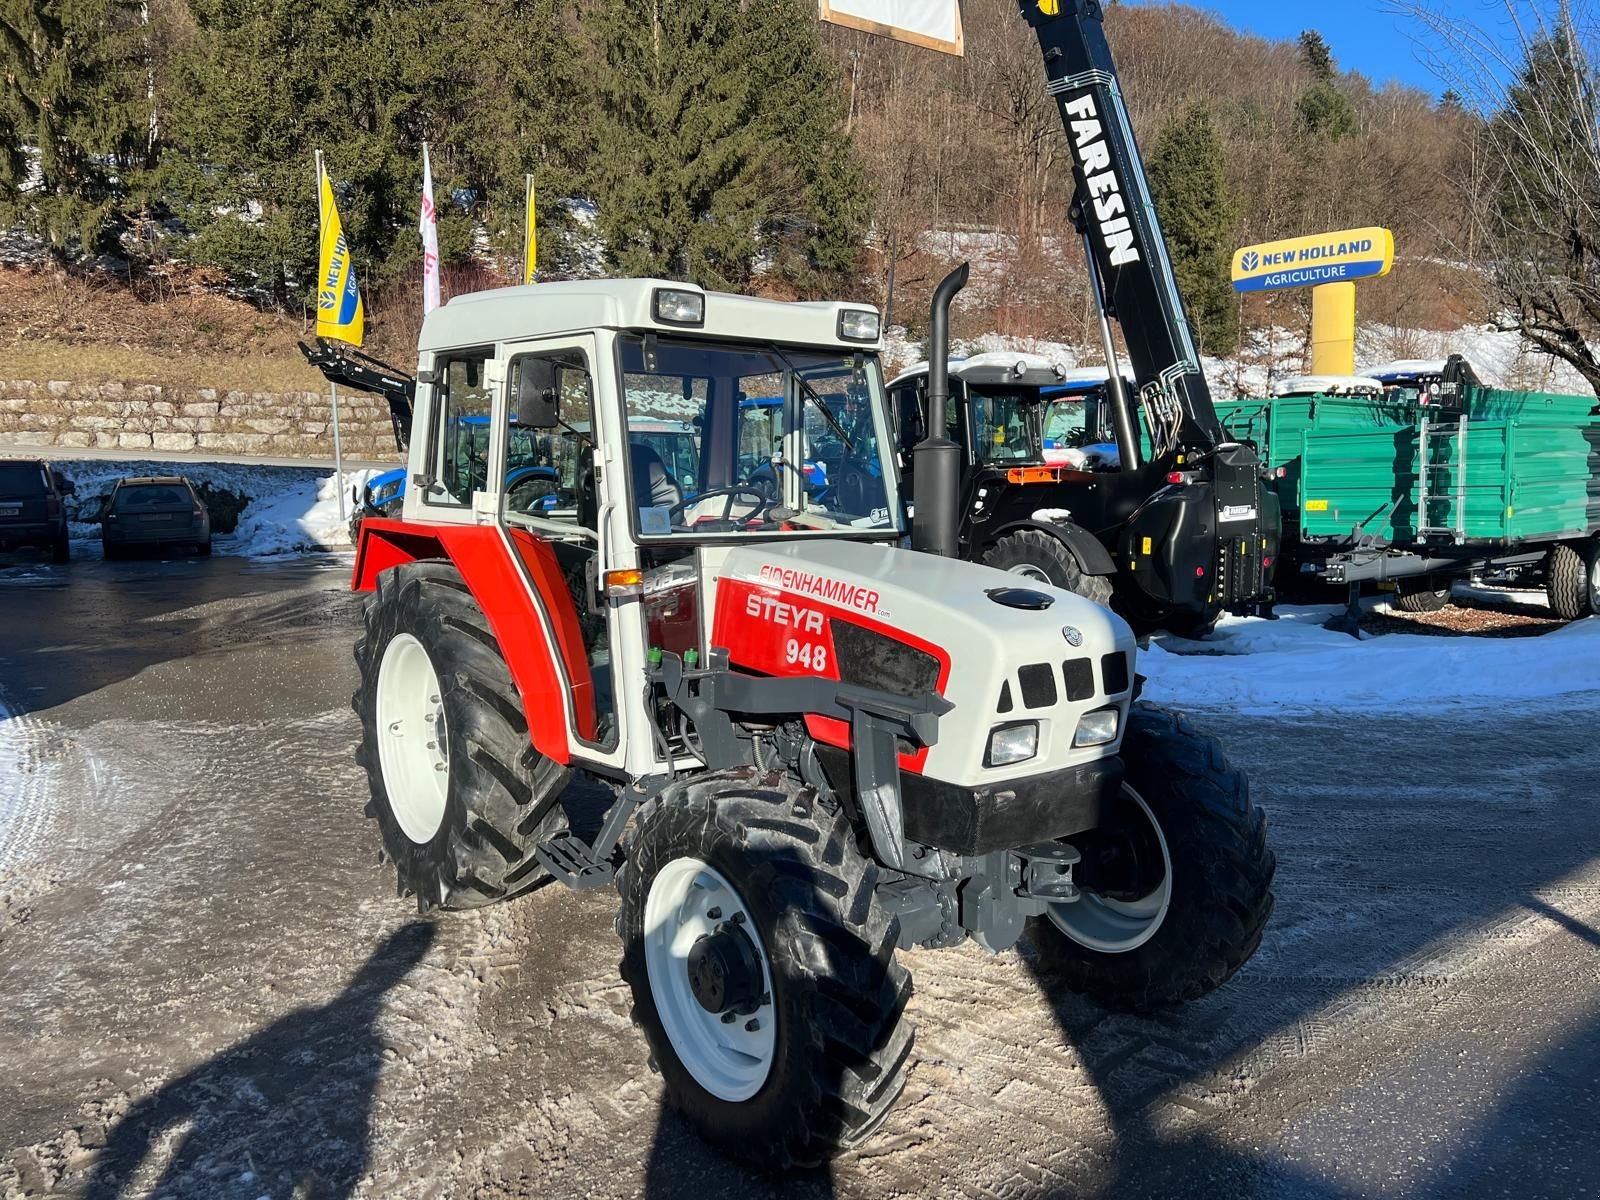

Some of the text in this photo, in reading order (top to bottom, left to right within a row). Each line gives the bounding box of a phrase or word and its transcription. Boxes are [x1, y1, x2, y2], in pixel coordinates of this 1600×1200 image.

[1065, 94, 1140, 266] FARESIN
[1263, 240, 1372, 266] NEW HOLLAND
[326, 256, 343, 288] NEW
[1264, 265, 1346, 286] AGRICULTURE
[746, 594, 824, 635] STEYR
[786, 638, 827, 672] 948
